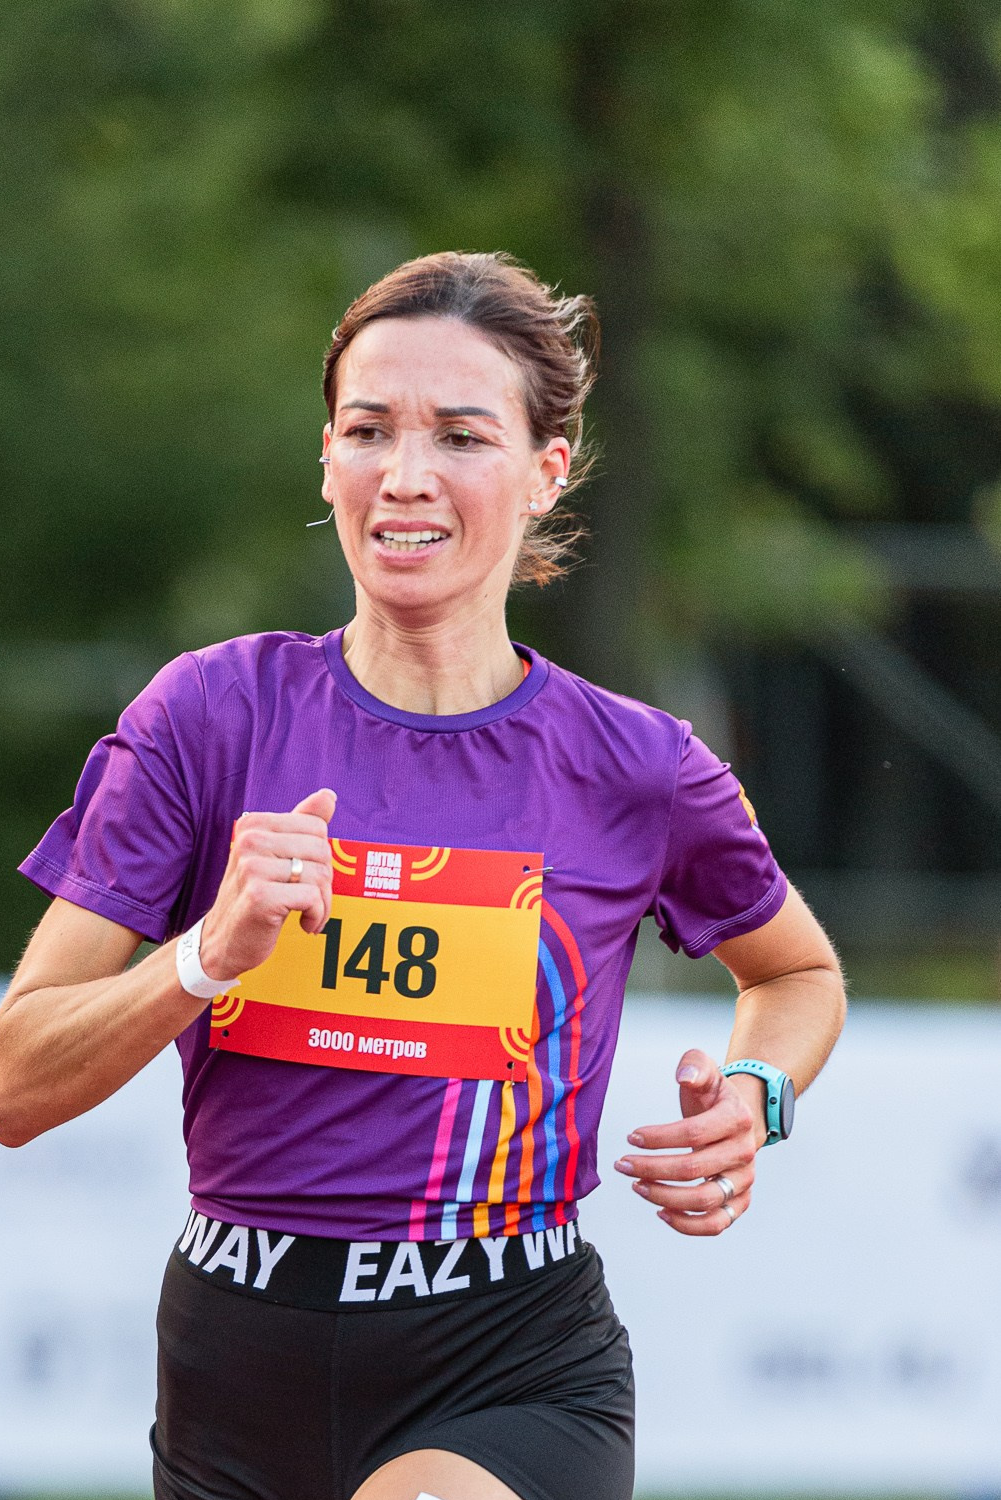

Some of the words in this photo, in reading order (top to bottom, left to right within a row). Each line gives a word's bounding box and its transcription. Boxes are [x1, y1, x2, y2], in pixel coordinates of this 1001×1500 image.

[366, 850, 402, 868] БИТВА
[319, 917, 440, 999] 148
[308, 1027, 355, 1052] 3000
[358, 1036, 427, 1060] метров
[178, 1209, 296, 1290] WAY
